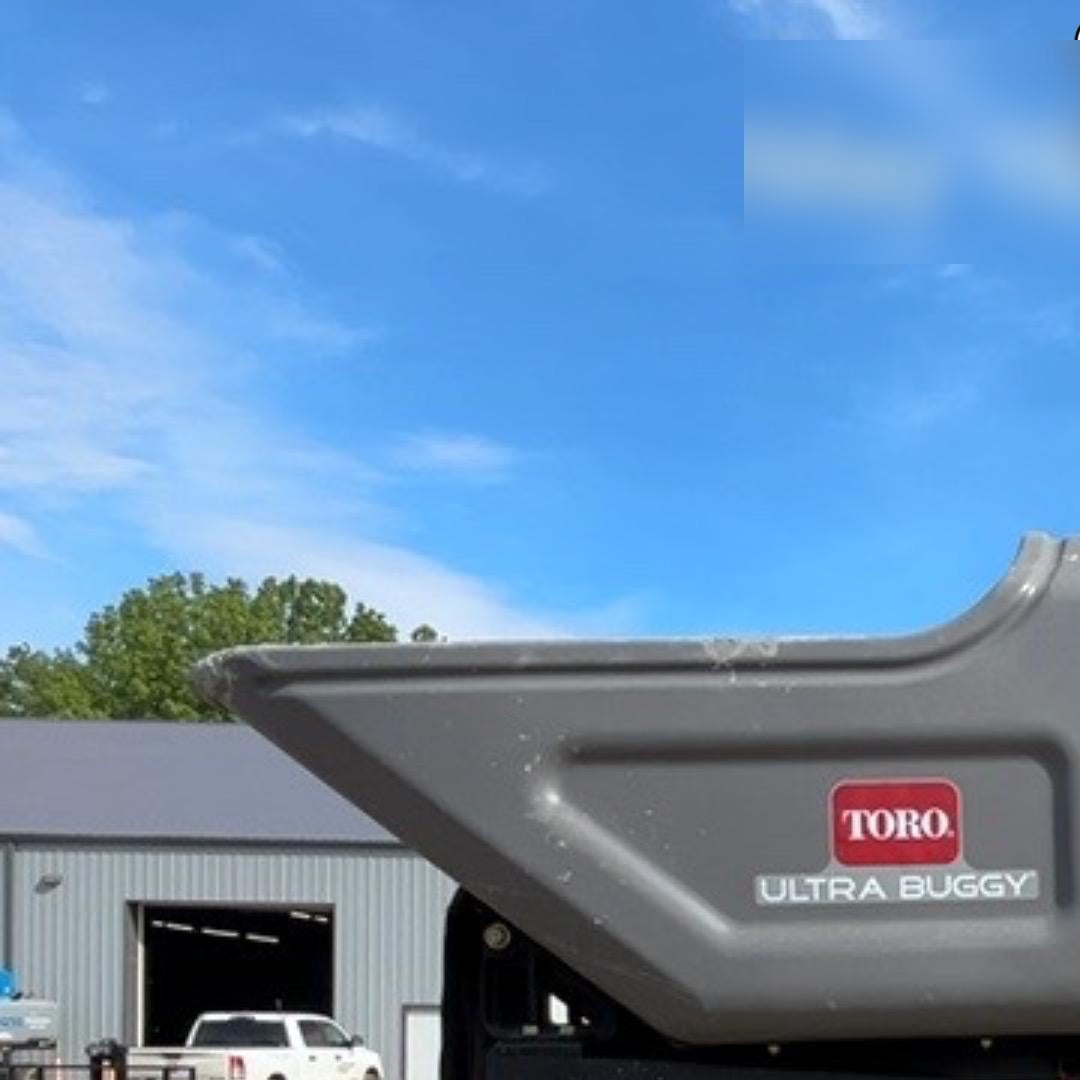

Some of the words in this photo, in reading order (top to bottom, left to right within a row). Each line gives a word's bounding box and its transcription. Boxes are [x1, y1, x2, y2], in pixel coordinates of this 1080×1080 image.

[843, 807, 949, 841] TORO
[760, 876, 886, 903] ULTRA
[900, 873, 1029, 899] BUGGY
